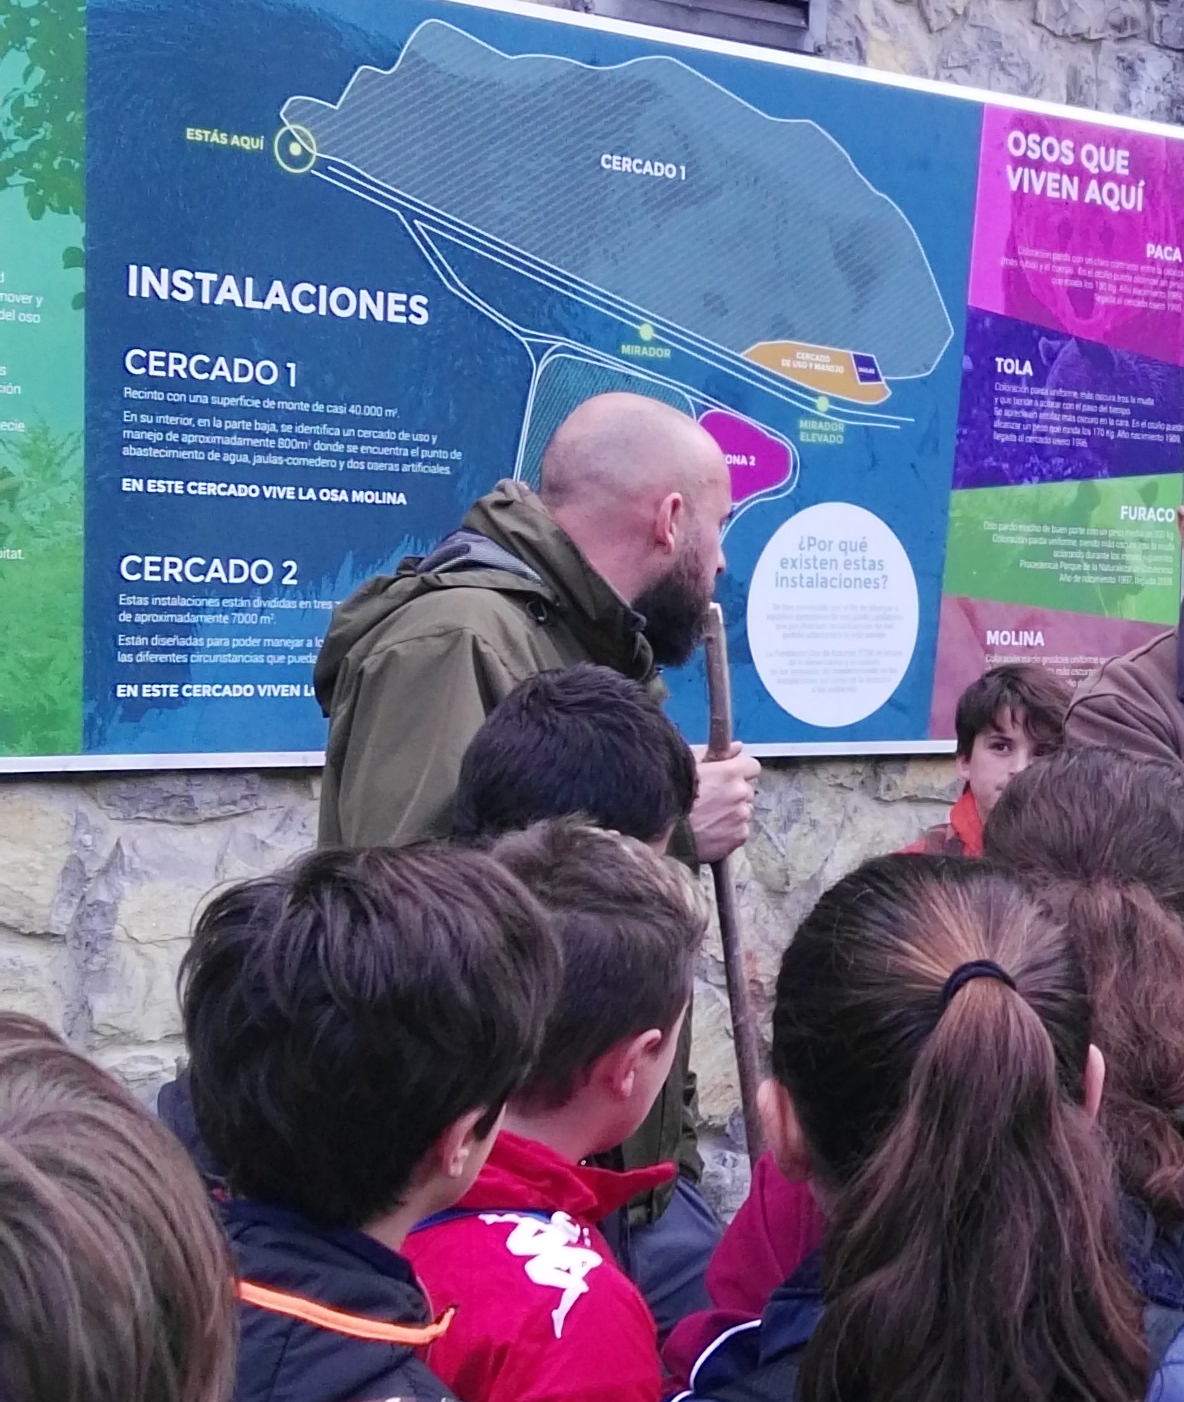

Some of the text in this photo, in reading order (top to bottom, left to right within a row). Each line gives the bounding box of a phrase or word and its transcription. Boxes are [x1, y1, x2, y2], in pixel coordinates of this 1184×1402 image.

[186, 127, 265, 150] ESTÁS AQUÍ
[1007, 130, 1130, 176] OSOS QUE
[600, 153, 686, 180] CERCADO 1
[1006, 164, 1145, 212] VIVEN AQUÍ
[1146, 242, 1183, 263] PACA
[127, 264, 430, 326] INSTALACIONES
[18, 312, 41, 323] oso
[621, 344, 671, 358] MIRADOR
[124, 348, 297, 387] CERCADO 1
[995, 357, 1033, 377] TOLA
[123, 387, 165, 401] Recinto
[166, 392, 186, 402] con
[188, 393, 209, 404] una
[211, 395, 261, 408] superficie
[262, 397, 275, 409] de
[277, 399, 310, 411] monte
[312, 400, 324, 412] de
[326, 402, 347, 414] casi
[348, 403, 383, 416] 40.000
[123, 411, 138, 423] En
[140, 414, 153, 424] su
[155, 413, 195, 428] interior,
[197, 418, 210, 428] en
[212, 417, 222, 428] la
[224, 419, 252, 432] parte
[254, 420, 278, 435] baja,
[280, 424, 293, 433] se
[295, 422, 340, 437] identifica
[342, 428, 355, 438] un
[357, 429, 396, 440] cercado
[398, 430, 410, 441] de
[412, 432, 430, 443] uso
[800, 419, 844, 432] MIRADOR
[122, 430, 164, 444] manejo
[165, 431, 179, 442] de
[181, 433, 276, 448] aproximadamente
[313, 440, 344, 452] donde
[346, 444, 358, 453] se
[360, 444, 408, 456] encuentra
[410, 446, 419, 457] el
[420, 447, 448, 460] punto
[450, 448, 462, 460] de
[800, 432, 844, 444] ELEVADO
[122, 445, 205, 460] abastecimiento
[207, 450, 221, 461] de
[222, 452, 250, 465] agua,
[252, 452, 337, 468] jaulas-comedero
[338, 459, 345, 472] y
[346, 458, 365, 470] dos
[367, 461, 400, 472] oseras
[723, 453, 756, 466] ONA 2
[122, 478, 408, 506] EN ESTE CERCADO VIVE LA OSA MOLINA
[1120, 505, 1175, 523] FURACO
[798, 535, 868, 555] ¿Por qué
[120, 555, 298, 585] CERCADO 2
[780, 554, 884, 571] existen estas
[775, 571, 889, 590] instalaciones?
[119, 593, 149, 606] Estas
[151, 594, 220, 607] instalaciones
[222, 595, 251, 608] están
[252, 596, 297, 609] divididas
[299, 600, 312, 609] en
[313, 597, 333, 609] tres
[118, 610, 132, 622] de
[134, 611, 229, 625] aproximadamente
[231, 612, 258, 624] 7000
[118, 634, 148, 646] Están
[150, 634, 204, 646] diseñadas
[206, 637, 230, 649] para
[232, 635, 261, 650] poder
[263, 635, 305, 650] manejar
[306, 638, 313, 647] a
[986, 630, 1045, 647] MOLINA
[117, 650, 134, 662] las
[135, 650, 188, 663] diferentes
[190, 651, 265, 663] circunstancias
[266, 654, 286, 666] que
[116, 684, 139, 697] EN
[142, 684, 179, 697] ESTE
[181, 684, 255, 697] CERCADO
[257, 684, 300, 697] VIVEN
